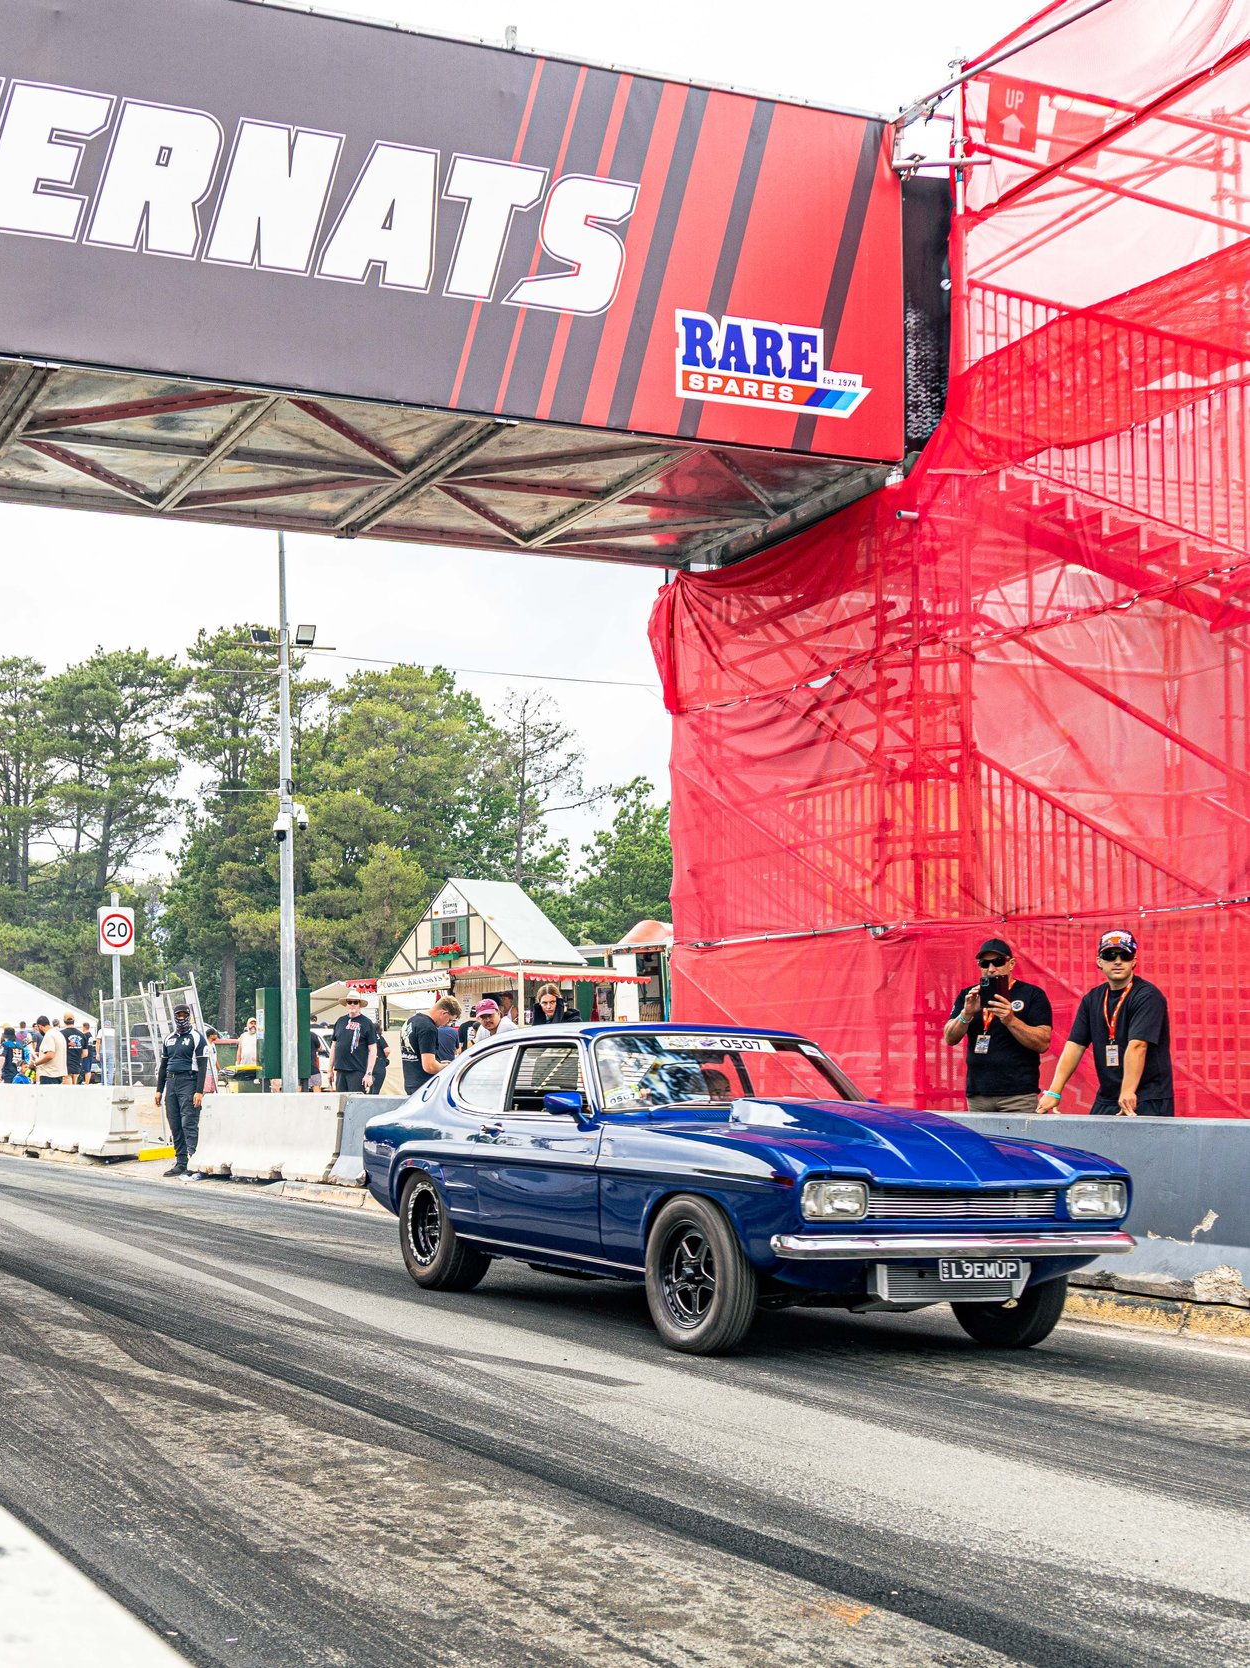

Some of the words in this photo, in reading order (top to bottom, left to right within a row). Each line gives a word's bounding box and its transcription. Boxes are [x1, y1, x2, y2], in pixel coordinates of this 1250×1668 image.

[1005, 88, 1025, 111] UP
[681, 316, 818, 383] RARE
[688, 373, 795, 402] SPARES
[838, 378, 857, 388] 1974
[106, 922, 128, 938] 20
[719, 1038, 762, 1051] 0507
[950, 1262, 1018, 1279] L9EMUP
